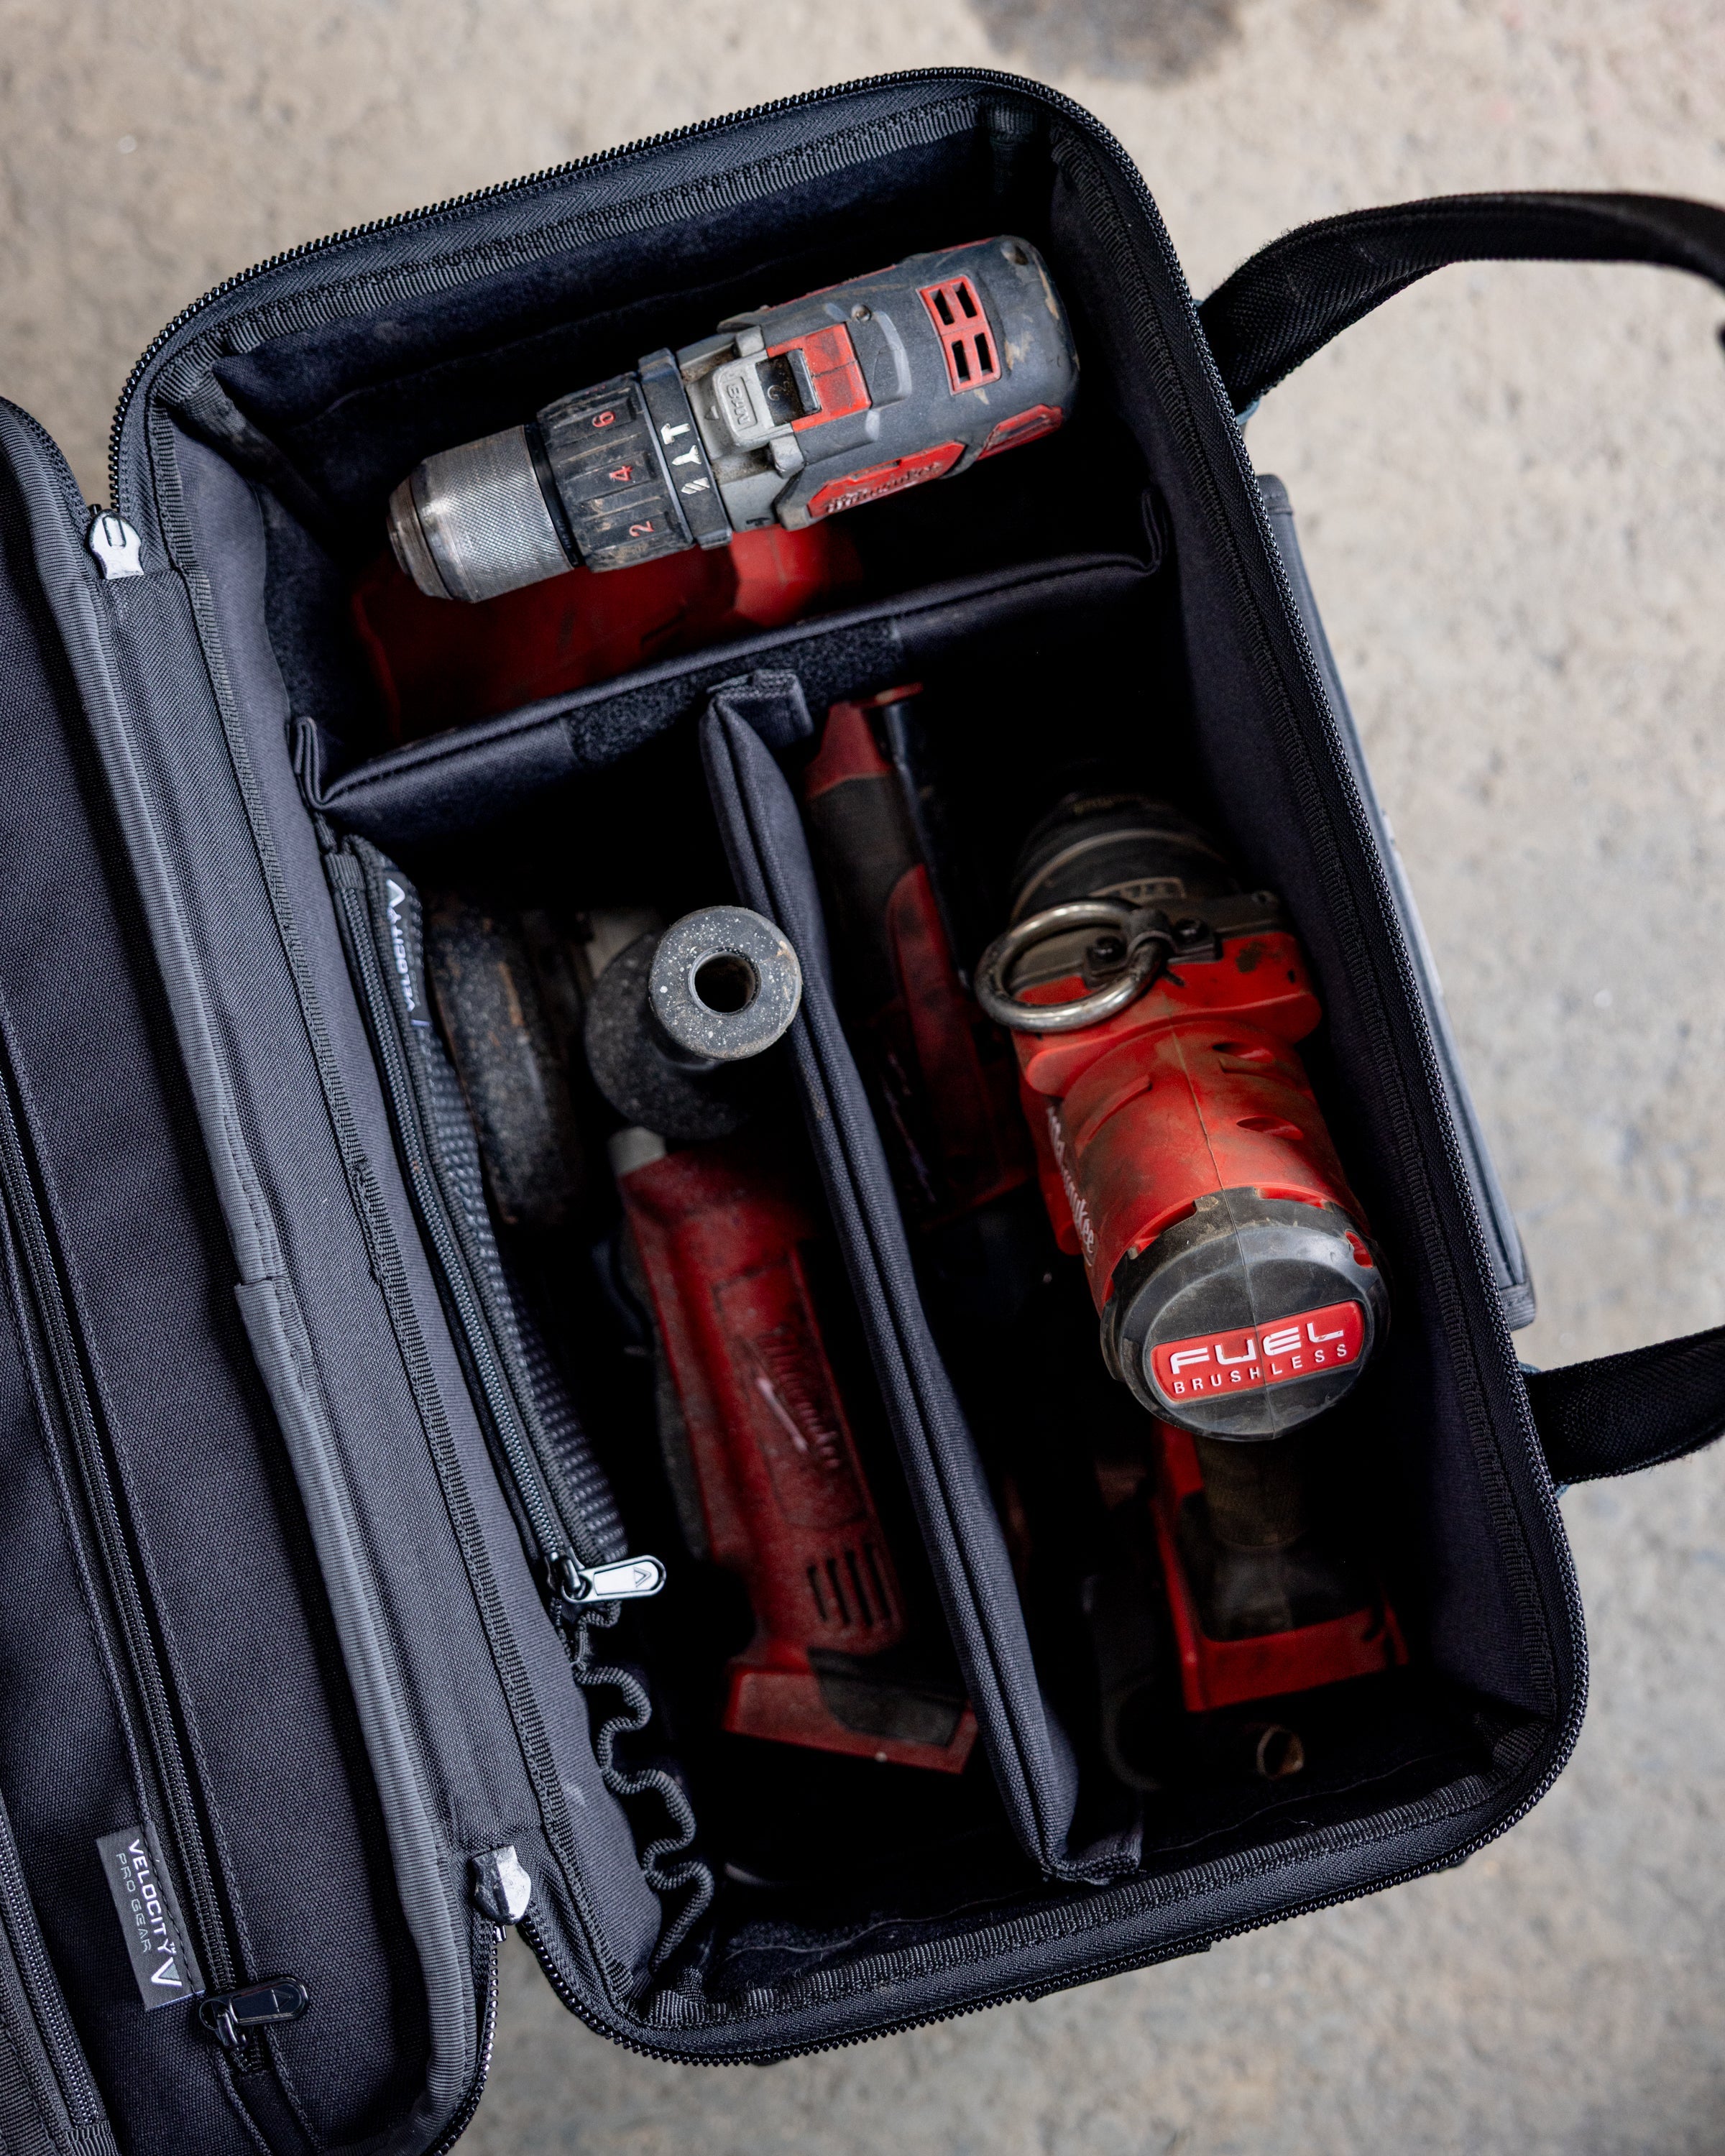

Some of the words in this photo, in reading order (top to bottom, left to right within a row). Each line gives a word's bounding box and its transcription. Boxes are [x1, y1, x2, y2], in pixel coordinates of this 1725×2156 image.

[592, 410, 616, 428] 6
[727, 384, 751, 425] M18
[609, 465, 632, 482] 4
[629, 520, 654, 537] 2
[1170, 1322, 1344, 1374] FUEL
[1172, 1343, 1348, 1394] BRUSHLESS
[116, 1852, 137, 1893] PRO
[131, 1898, 153, 1953] GEAR
